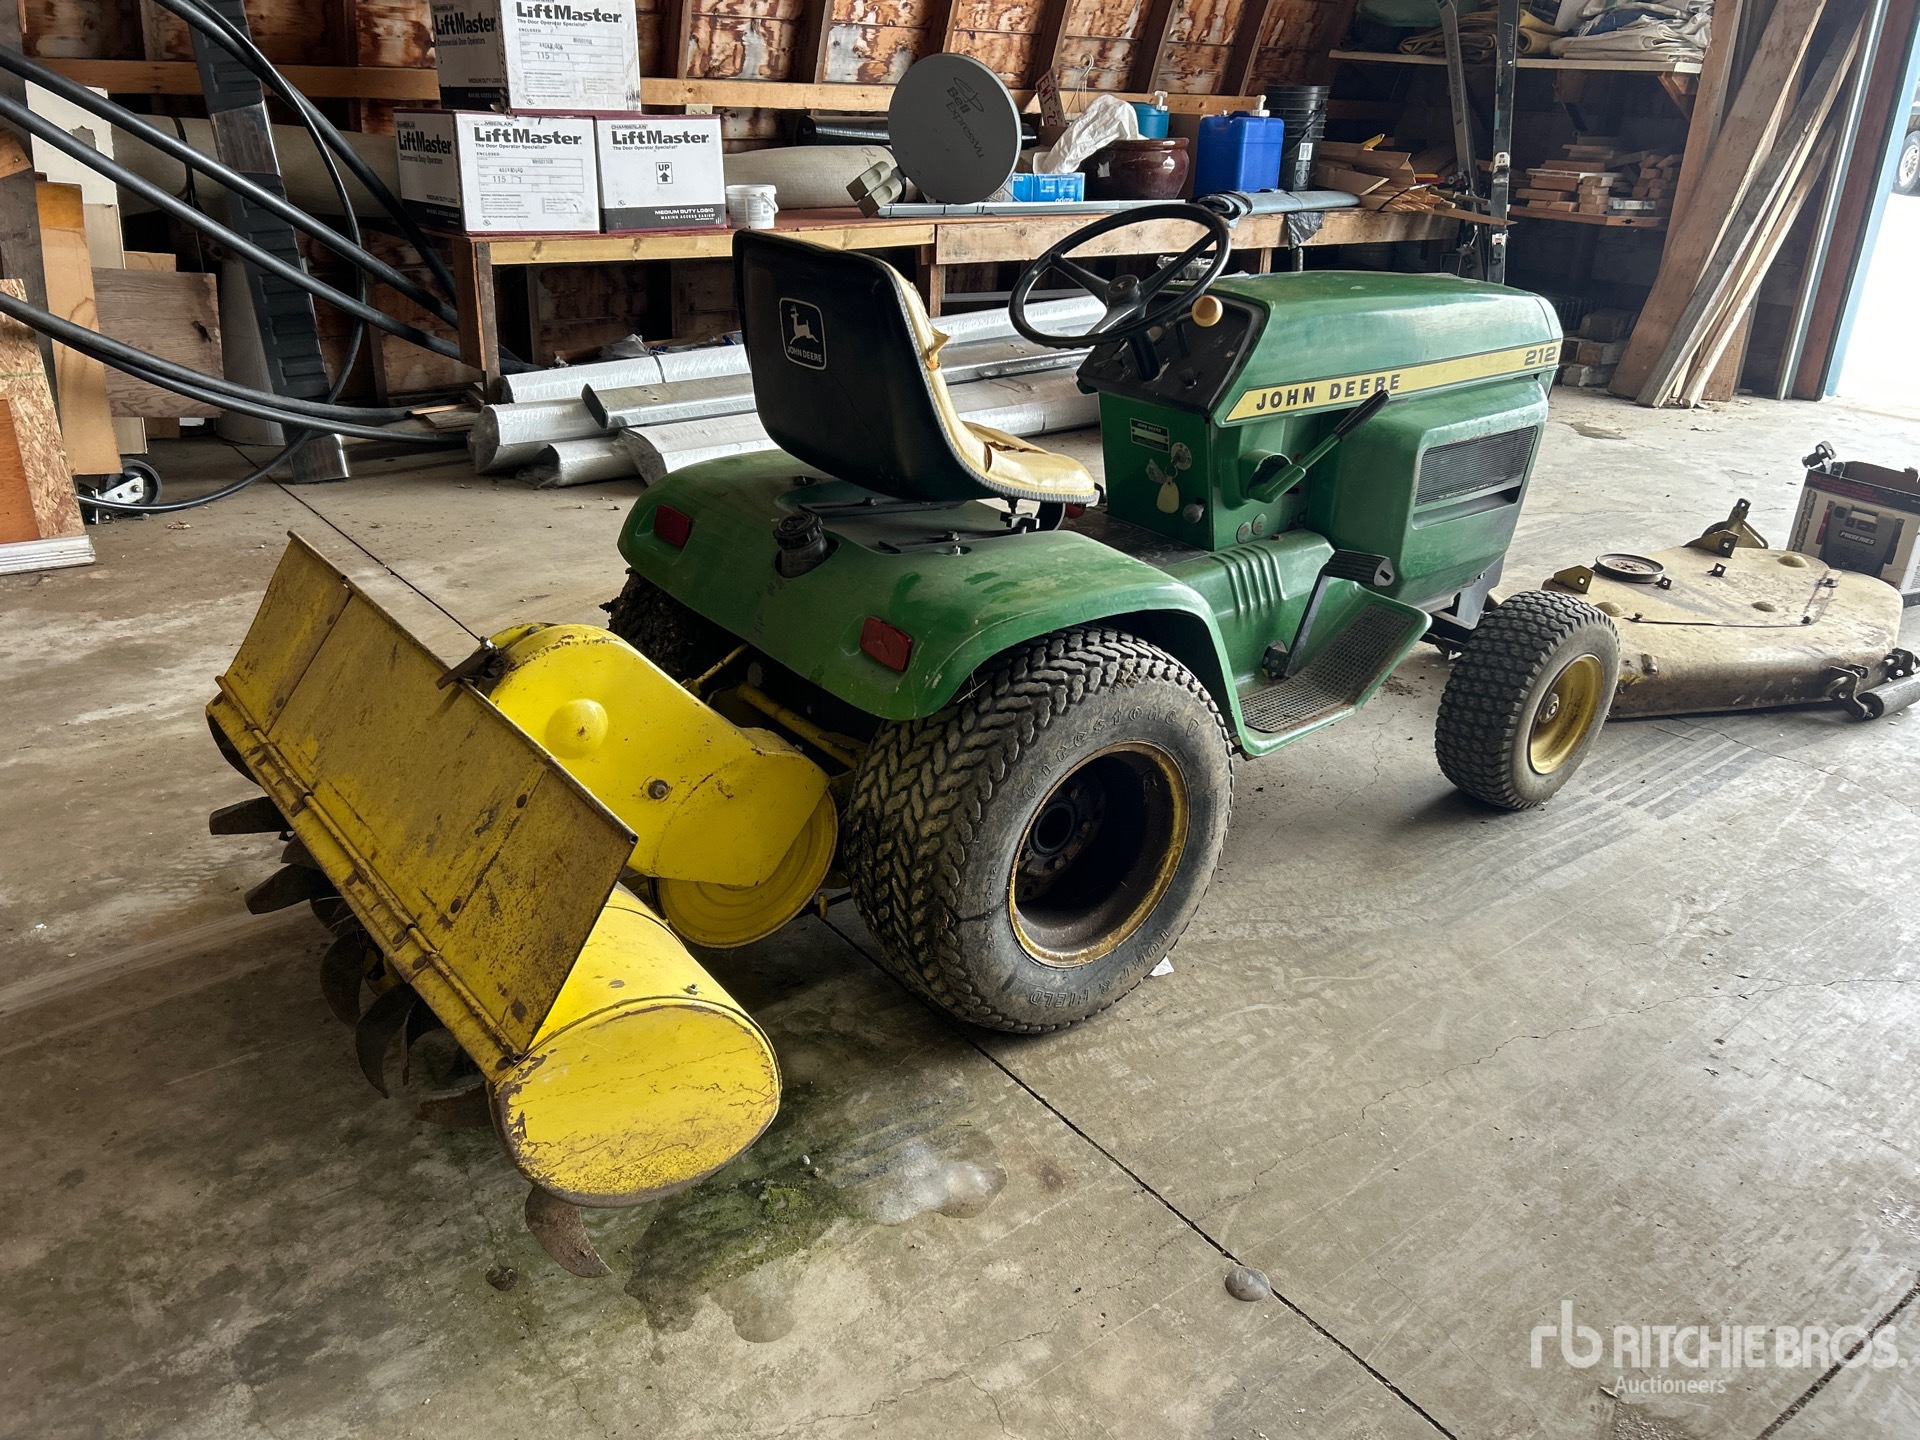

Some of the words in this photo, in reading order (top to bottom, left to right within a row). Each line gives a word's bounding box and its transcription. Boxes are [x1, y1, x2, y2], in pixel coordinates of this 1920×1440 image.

[516, 1, 622, 23] LiftMaster
[434, 12, 496, 35] LiftMaster
[537, 51, 550, 60] 115
[946, 86, 971, 114] Bell
[473, 127, 582, 145] LiftMaster
[611, 130, 709, 145] LiftMaster
[945, 102, 985, 158] ExpressVu
[397, 130, 452, 154] LiftMaster
[493, 175, 507, 183] 115
[787, 345, 802, 357] JOHN
[802, 349, 823, 363] DEERE
[1524, 345, 1557, 367] 212
[1256, 386, 1316, 411] JOHN
[1329, 374, 1402, 401] DEERE
[1840, 530, 1875, 546] PROSERIES
[1028, 987, 1091, 1009] FIELD
